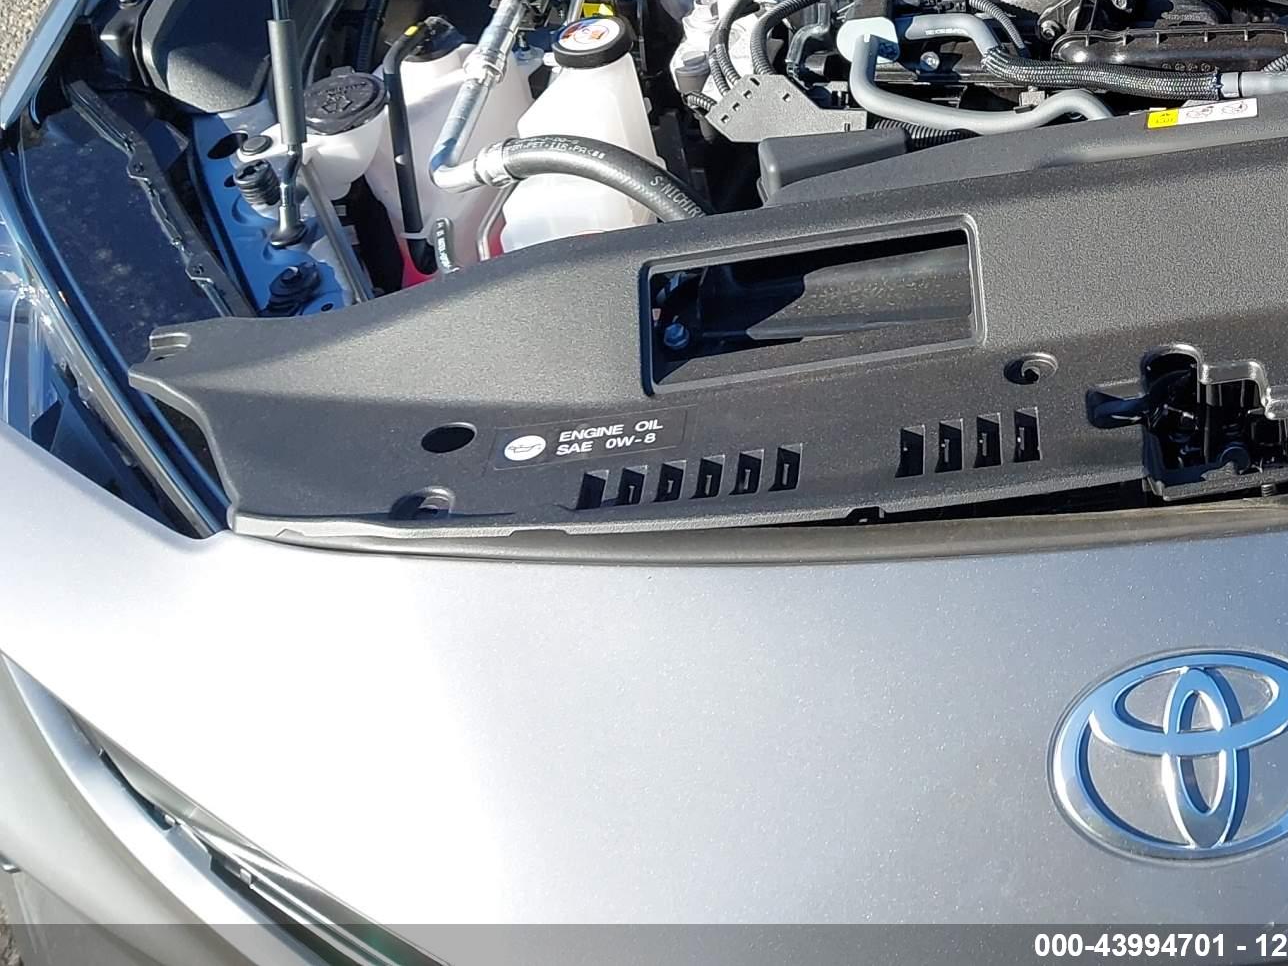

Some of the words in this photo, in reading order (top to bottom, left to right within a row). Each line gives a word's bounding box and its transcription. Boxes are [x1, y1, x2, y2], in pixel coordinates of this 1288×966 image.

[558, 424, 625, 443] ENGINE
[634, 419, 664, 432] OIL
[556, 441, 594, 456] SAE
[605, 433, 657, 449] 0W-8
